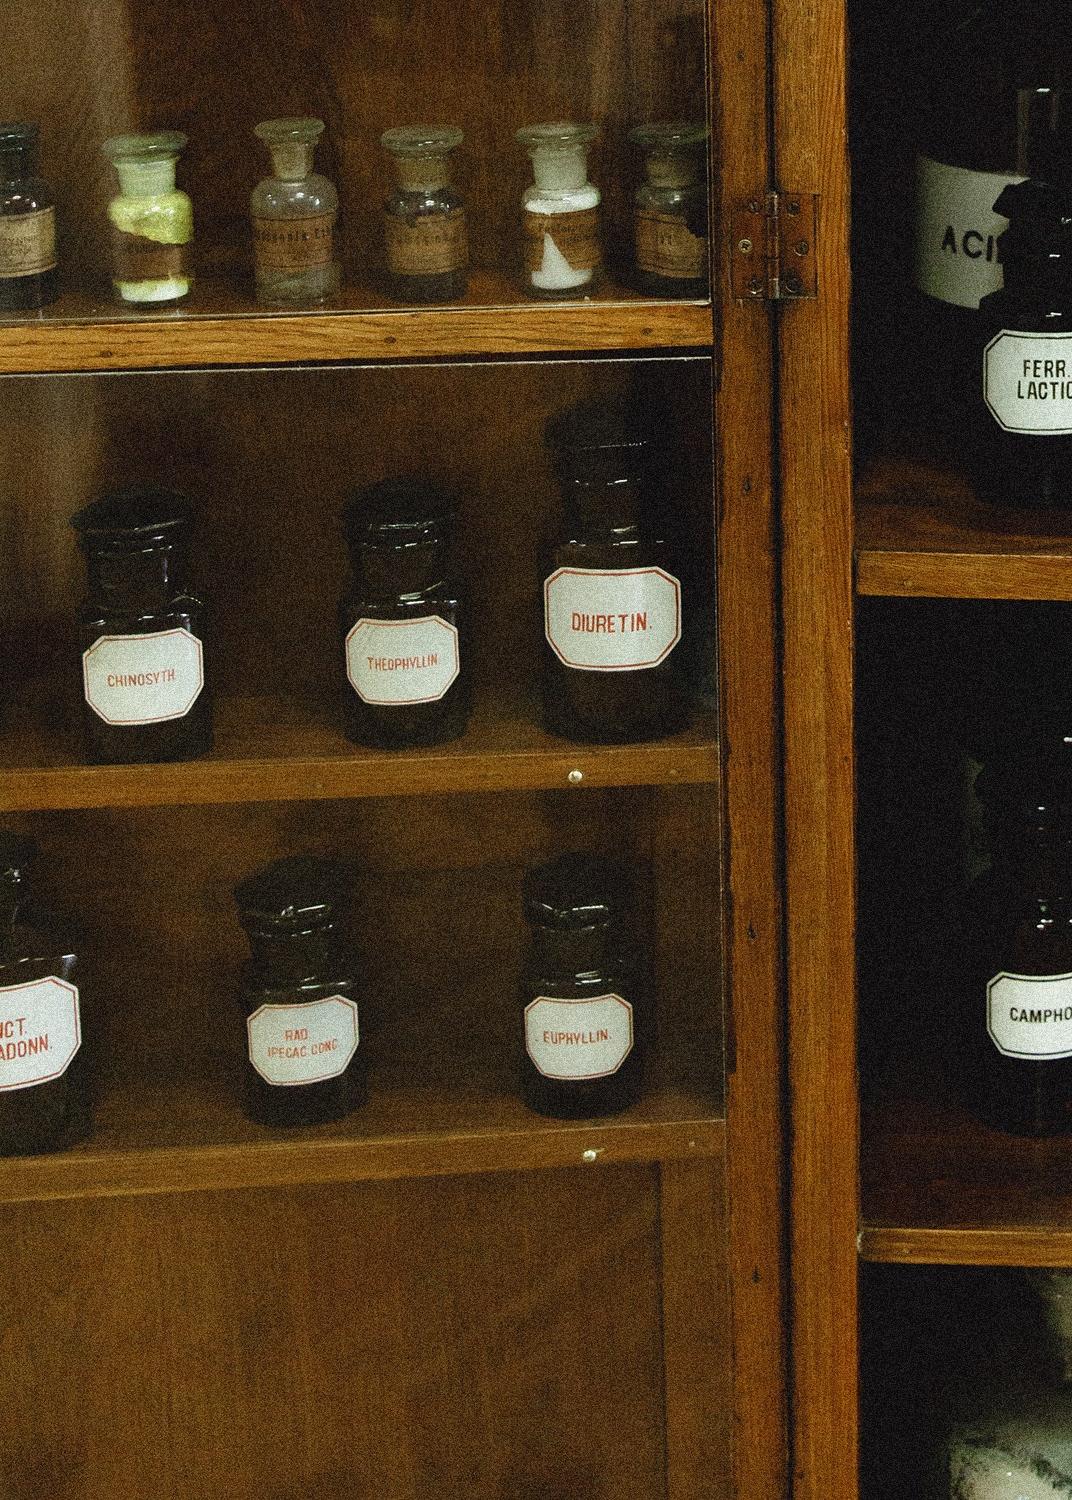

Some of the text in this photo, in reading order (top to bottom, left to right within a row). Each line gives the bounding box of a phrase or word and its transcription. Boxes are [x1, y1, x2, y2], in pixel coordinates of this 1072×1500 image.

[941, 225, 1004, 264] ACI
[1022, 359, 1071, 378] FERR.
[571, 612, 653, 633] DIURETIN.
[367, 654, 438, 671] THEOPHYLLIN
[285, 1028, 309, 1042] RAD
[543, 1029, 612, 1045] EUPHYLLIN.
